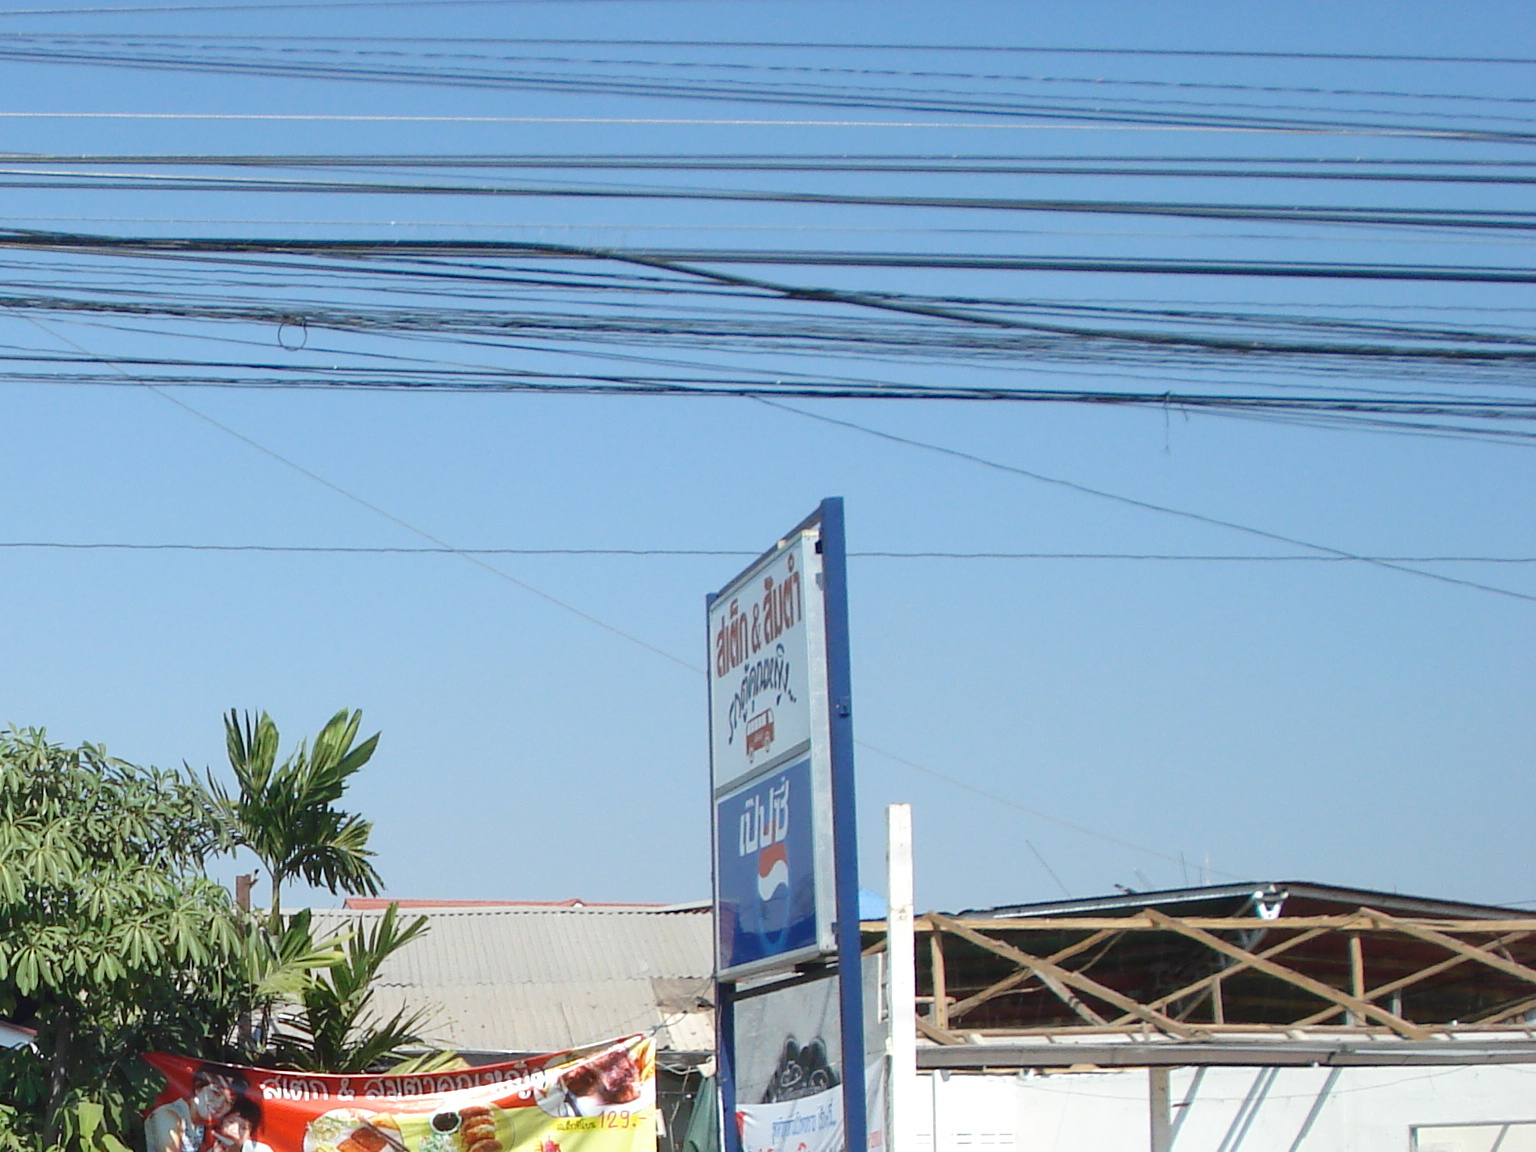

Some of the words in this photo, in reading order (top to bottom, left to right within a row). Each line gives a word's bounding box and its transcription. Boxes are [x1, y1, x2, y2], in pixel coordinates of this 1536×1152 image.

[716, 597, 749, 678] สเต็ก
[751, 602, 762, 654] &
[763, 552, 802, 645] ส้มตำ
[336, 1077, 357, 1102] &
[599, 1109, 647, 1129] 129.-
